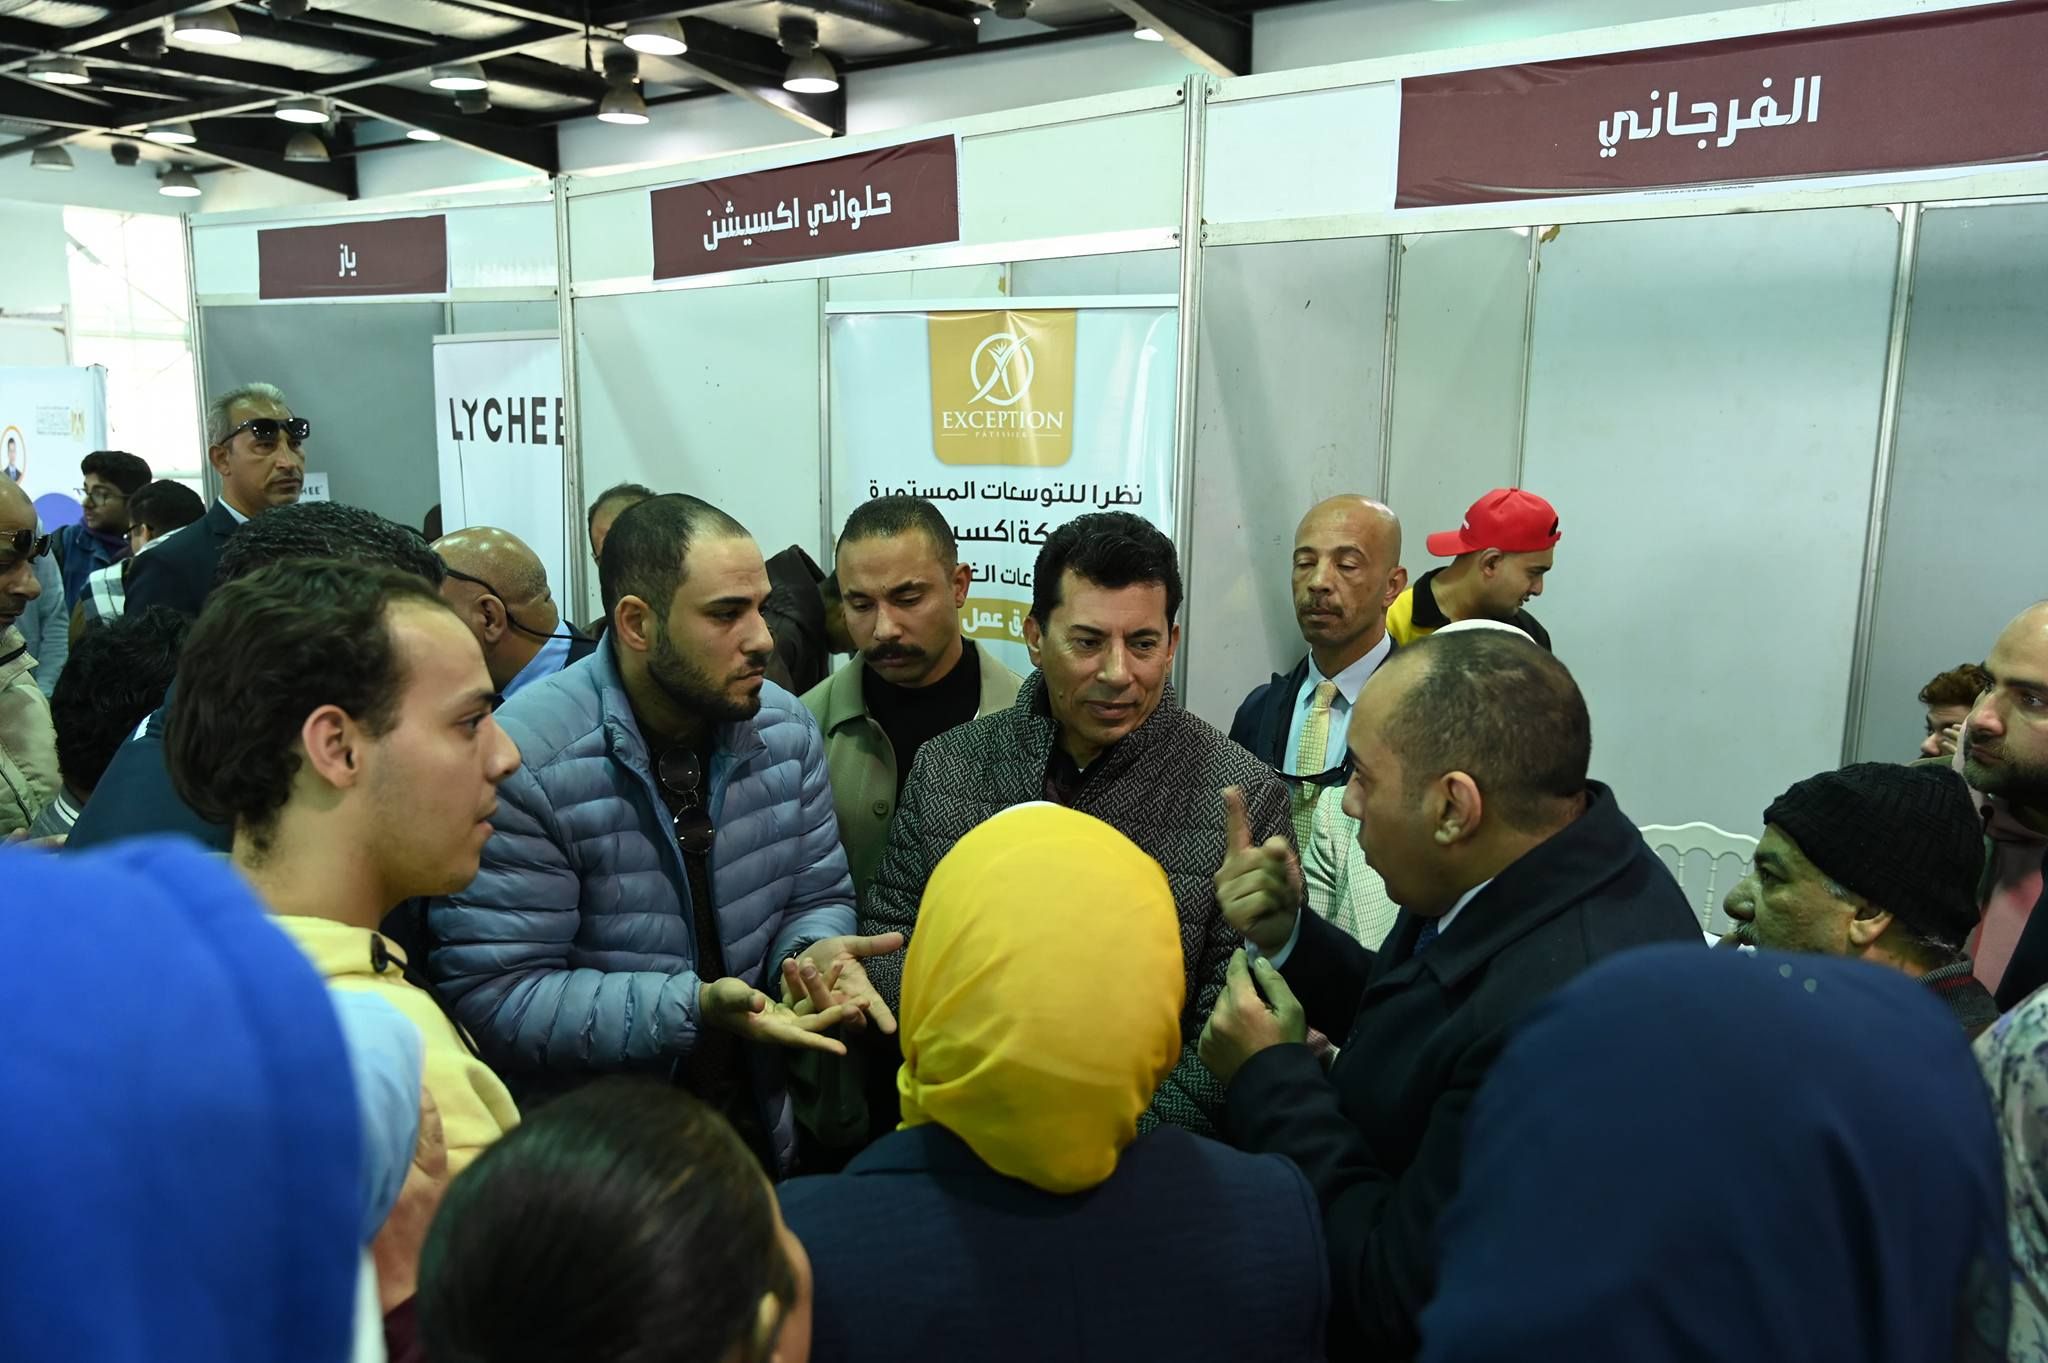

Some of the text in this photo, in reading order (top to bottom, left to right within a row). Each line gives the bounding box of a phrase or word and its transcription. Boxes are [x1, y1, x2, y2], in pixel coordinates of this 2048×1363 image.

[1598, 75, 1821, 158] الفرجاني
[703, 184, 892, 251] حلواني اكسيشن
[338, 243, 357, 277] ياز
[943, 410, 1064, 429] EXCEPTION
[981, 482, 1087, 507] للتوسعات
[1092, 484, 1143, 509] نظرا
[962, 607, 1004, 633] عمل
